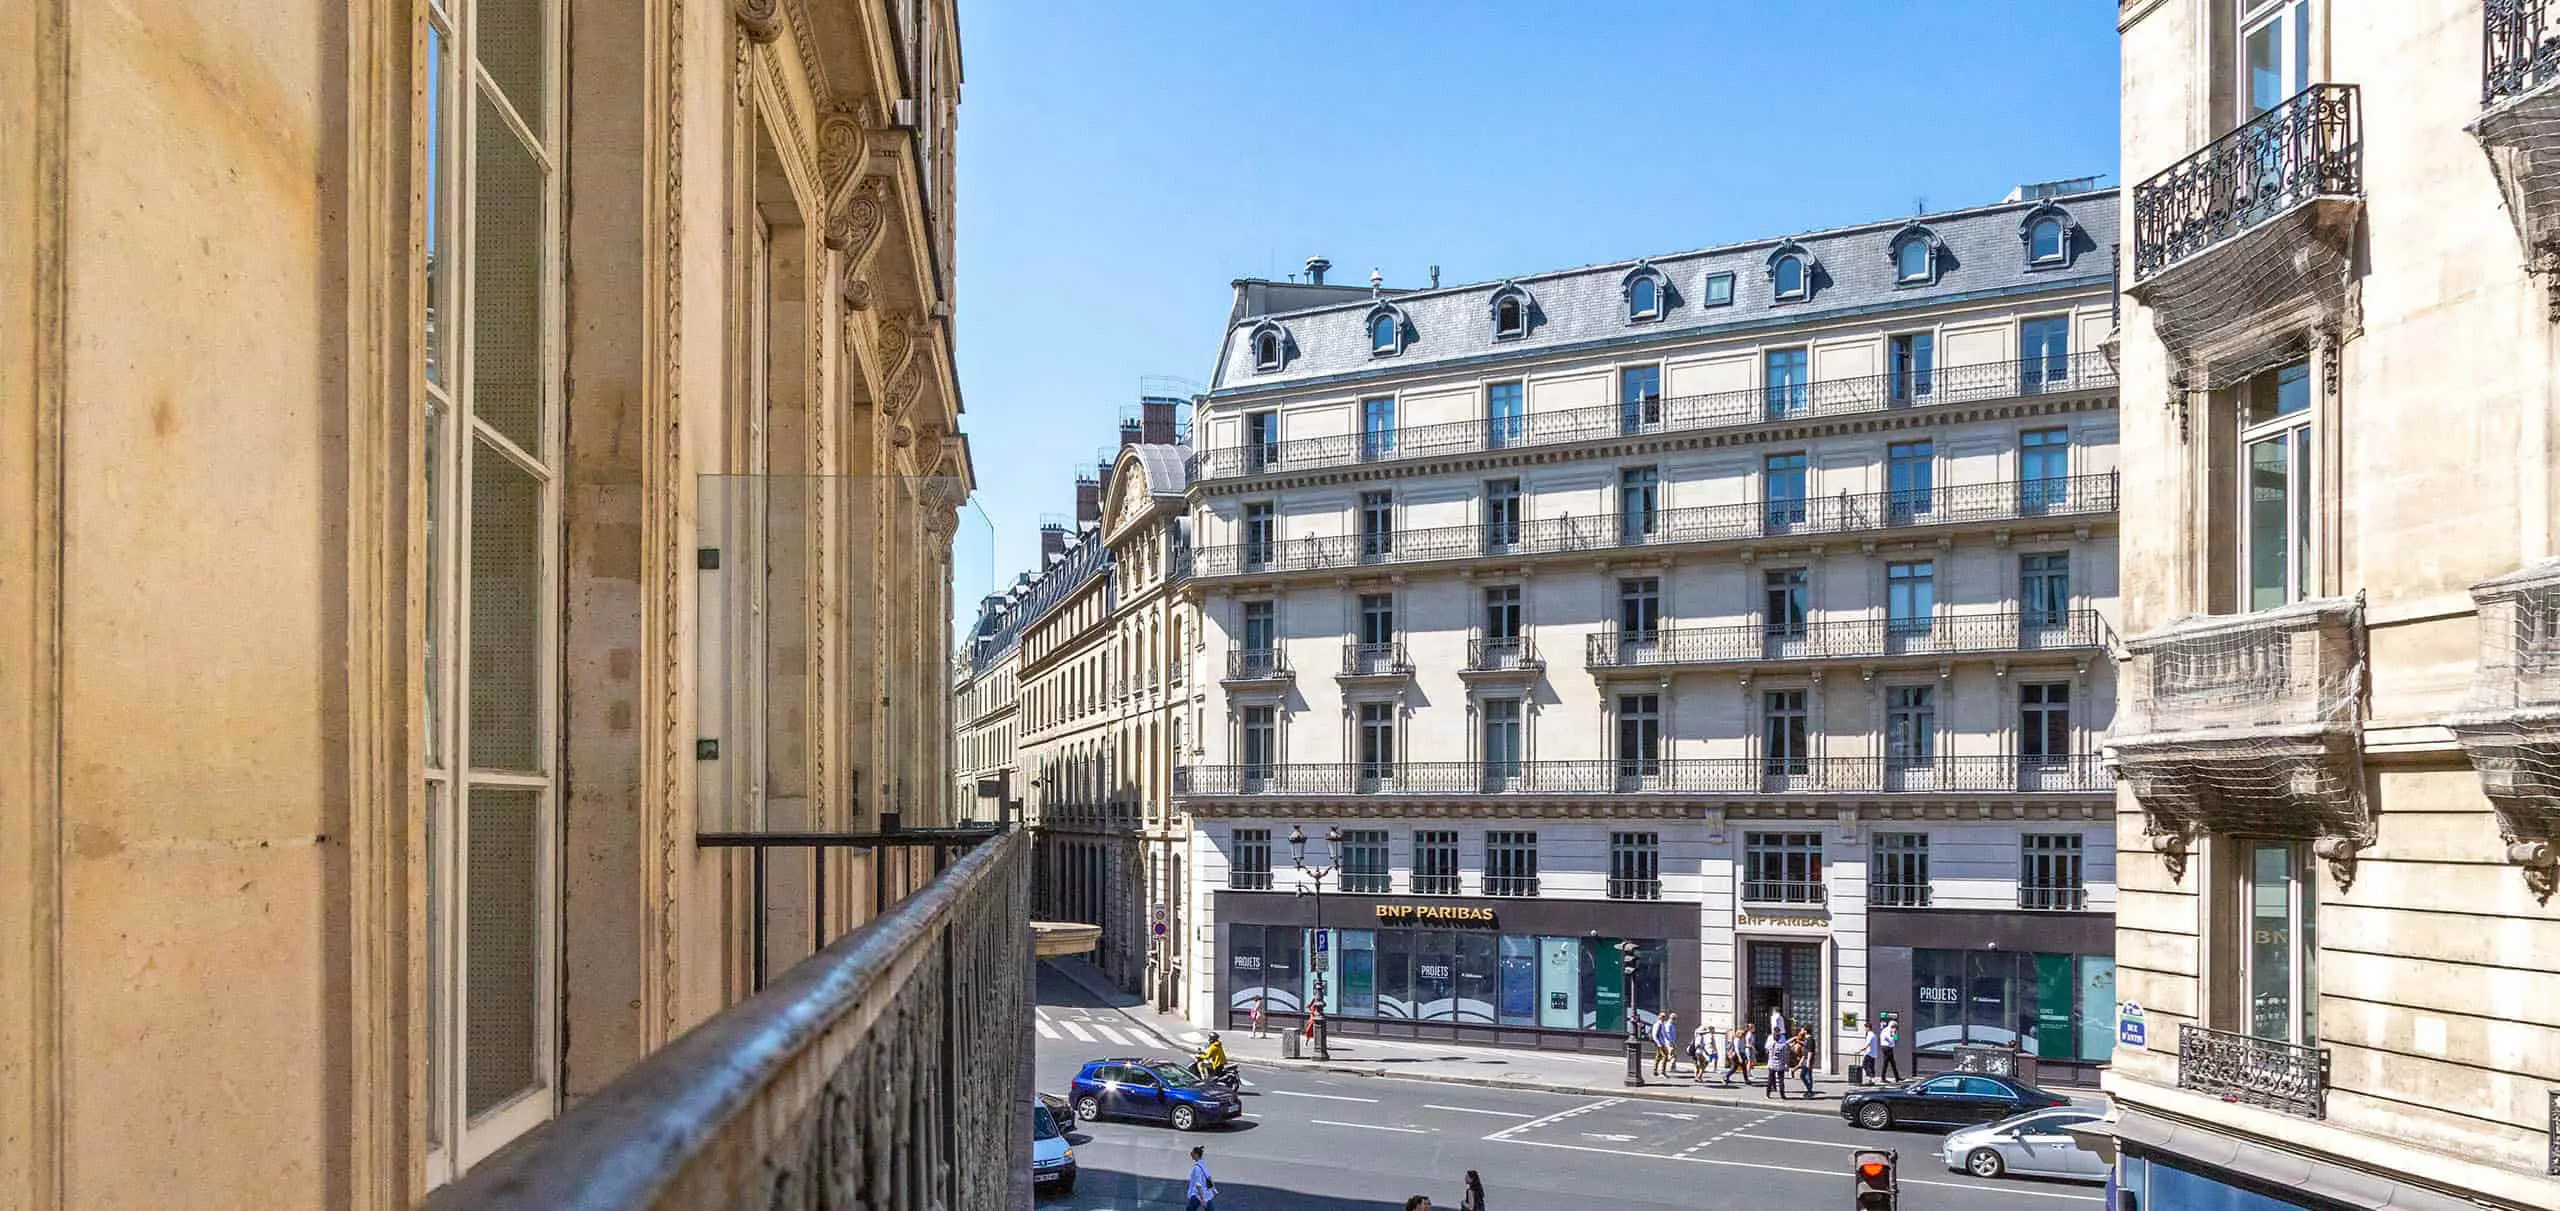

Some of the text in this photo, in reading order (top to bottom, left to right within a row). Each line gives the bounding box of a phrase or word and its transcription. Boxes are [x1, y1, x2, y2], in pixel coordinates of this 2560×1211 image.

[1376, 905, 1494, 920] BNP PARIBAS
[1738, 914, 1766, 925] BNP
[1234, 956, 1261, 967] PROJETS
[1421, 965, 1449, 977] PROJETS
[1920, 987, 1958, 1001] PROJETS
